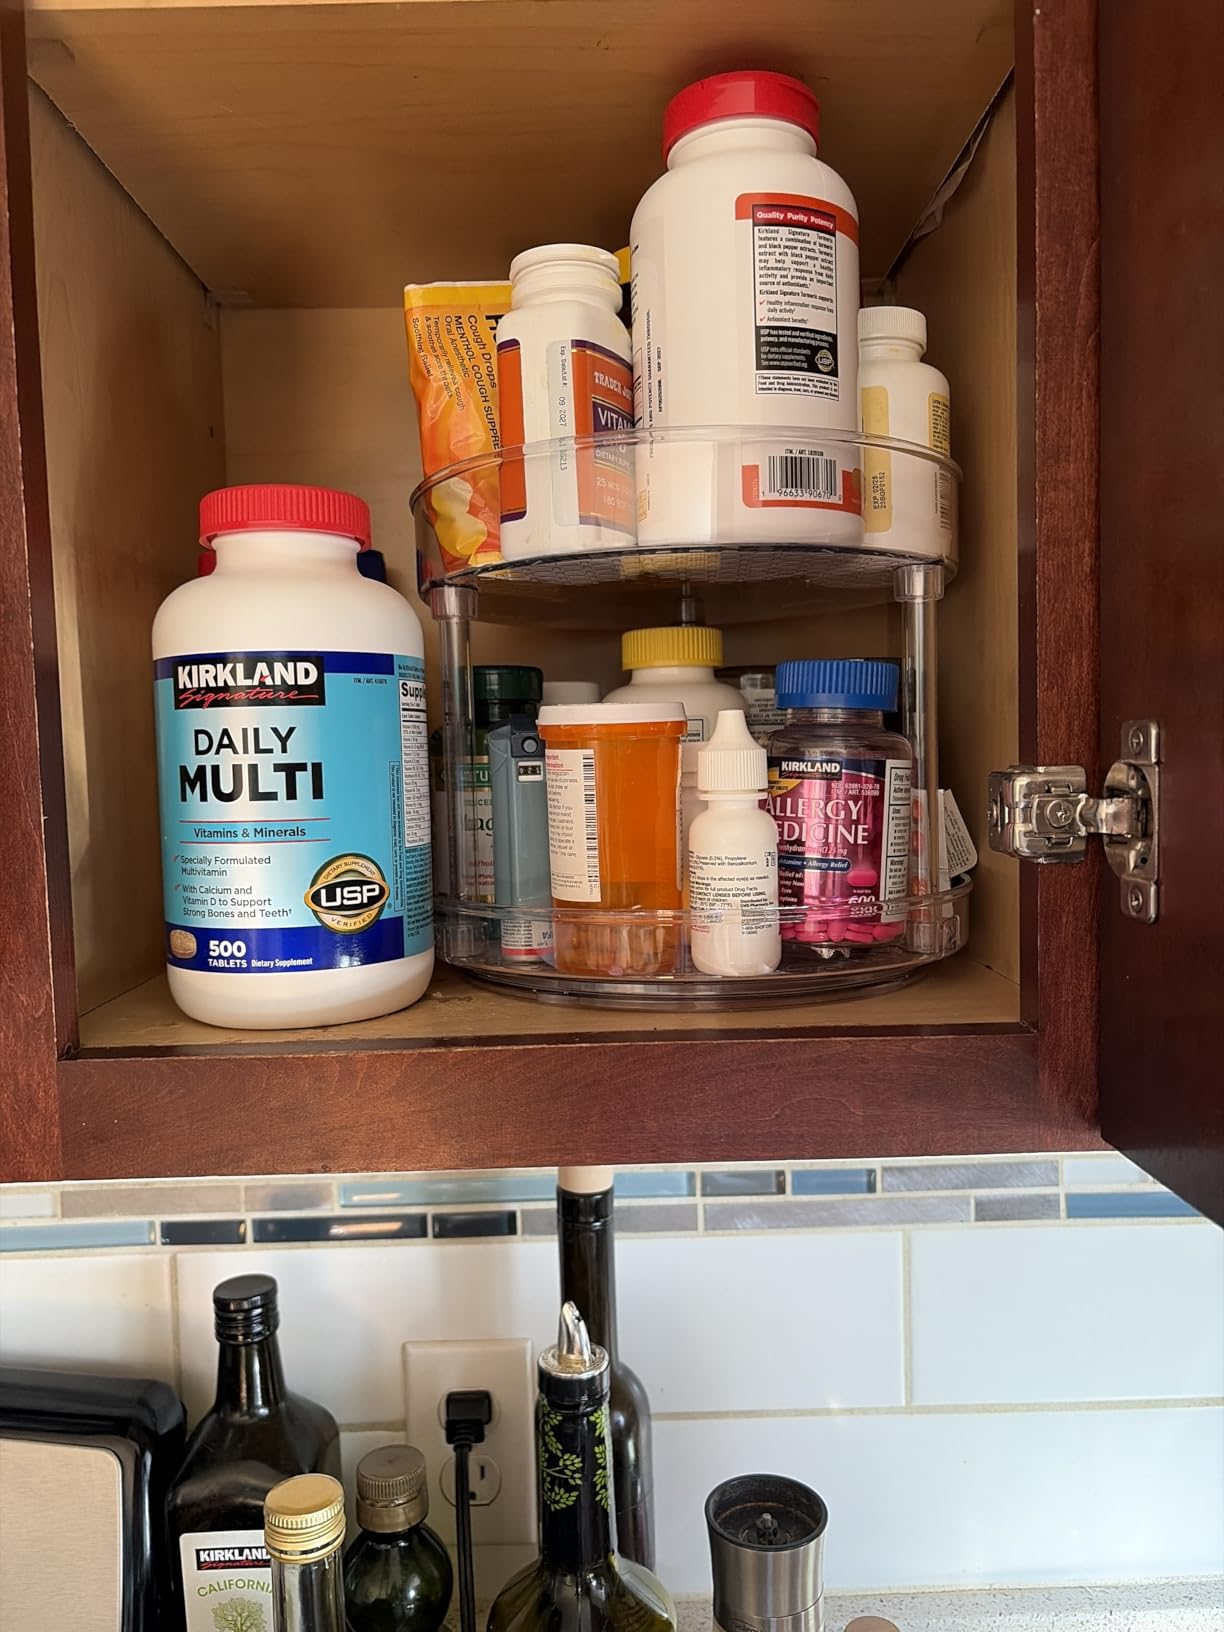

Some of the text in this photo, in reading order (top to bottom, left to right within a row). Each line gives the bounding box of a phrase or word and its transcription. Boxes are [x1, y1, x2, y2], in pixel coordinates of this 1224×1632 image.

[757, 211, 833, 229] Quality Purity Potency
[785, 237, 811, 245] combination
[788, 229, 810, 237] Signature
[412, 318, 434, 377] Soothing Relief
[445, 315, 470, 378] Oral Anesthetic
[468, 315, 486, 350] Cough
[481, 352, 497, 388] Drops
[426, 325, 437, 353] soothes
[434, 354, 444, 369] sore
[440, 371, 453, 399] throats
[433, 315, 464, 410] Temporarily relieves cough
[454, 315, 500, 450] MENTHOL COUGH SUPPRE
[594, 371, 621, 394] TRADER
[559, 397, 565, 406] 09
[778, 489, 804, 497] 96633
[808, 490, 830, 499] 90670
[178, 662, 318, 689] KIRKLAND
[179, 687, 319, 709] Signature
[194, 726, 296, 755] DAILY
[781, 761, 840, 773] KIRKLAND
[179, 762, 323, 802] MULTI
[766, 794, 863, 820] ALLERGY
[194, 826, 306, 838] Vitamins & Minerals
[777, 820, 869, 844] EDICINE
[181, 856, 271, 865] Specially Formulated
[808, 861, 828, 869] Allergy
[181, 867, 227, 876] Multivitamin
[323, 861, 376, 880] DIETARY SUPPLEMENT
[183, 885, 252, 895] With Calcium and
[320, 884, 380, 907] USP
[183, 896, 208, 905] Vitamin
[230, 898, 272, 908] Support
[183, 908, 205, 918] Strong
[208, 909, 235, 917] Bones
[237, 909, 255, 917] and
[330, 912, 373, 928] VERIFIED
[209, 940, 247, 957] 500
[208, 958, 312, 968] TABLETS Dietary Supplement
